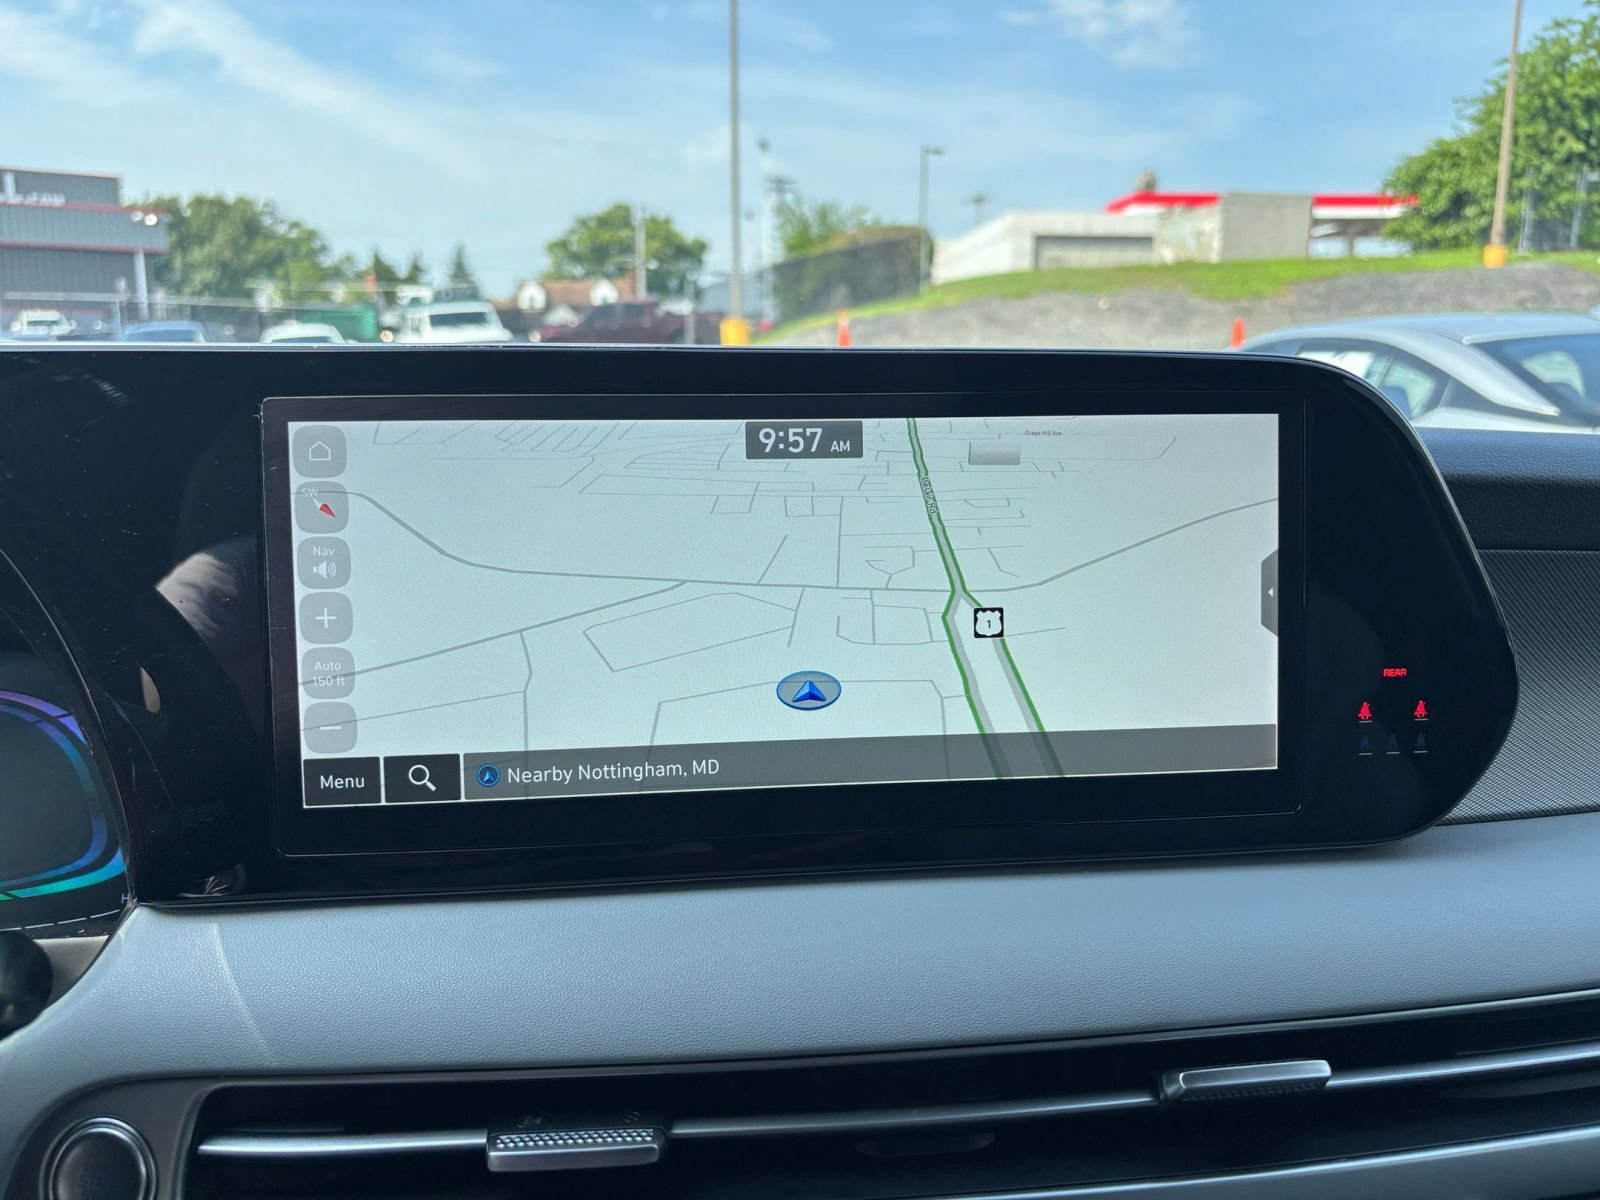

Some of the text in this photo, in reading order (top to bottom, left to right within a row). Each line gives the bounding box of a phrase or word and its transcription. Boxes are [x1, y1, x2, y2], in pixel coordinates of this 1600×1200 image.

[759, 427, 851, 453] 9:57 AM
[301, 487, 319, 498] SW
[920, 476, 937, 514] Belair Rd
[312, 545, 335, 557] Nav
[987, 619, 991, 630] 1
[314, 660, 342, 671] Auto
[1383, 668, 1407, 678] REAR
[312, 673, 345, 687] 150 ft
[507, 759, 720, 785] Nearby Nottingham, MD
[319, 774, 366, 790] Menu
